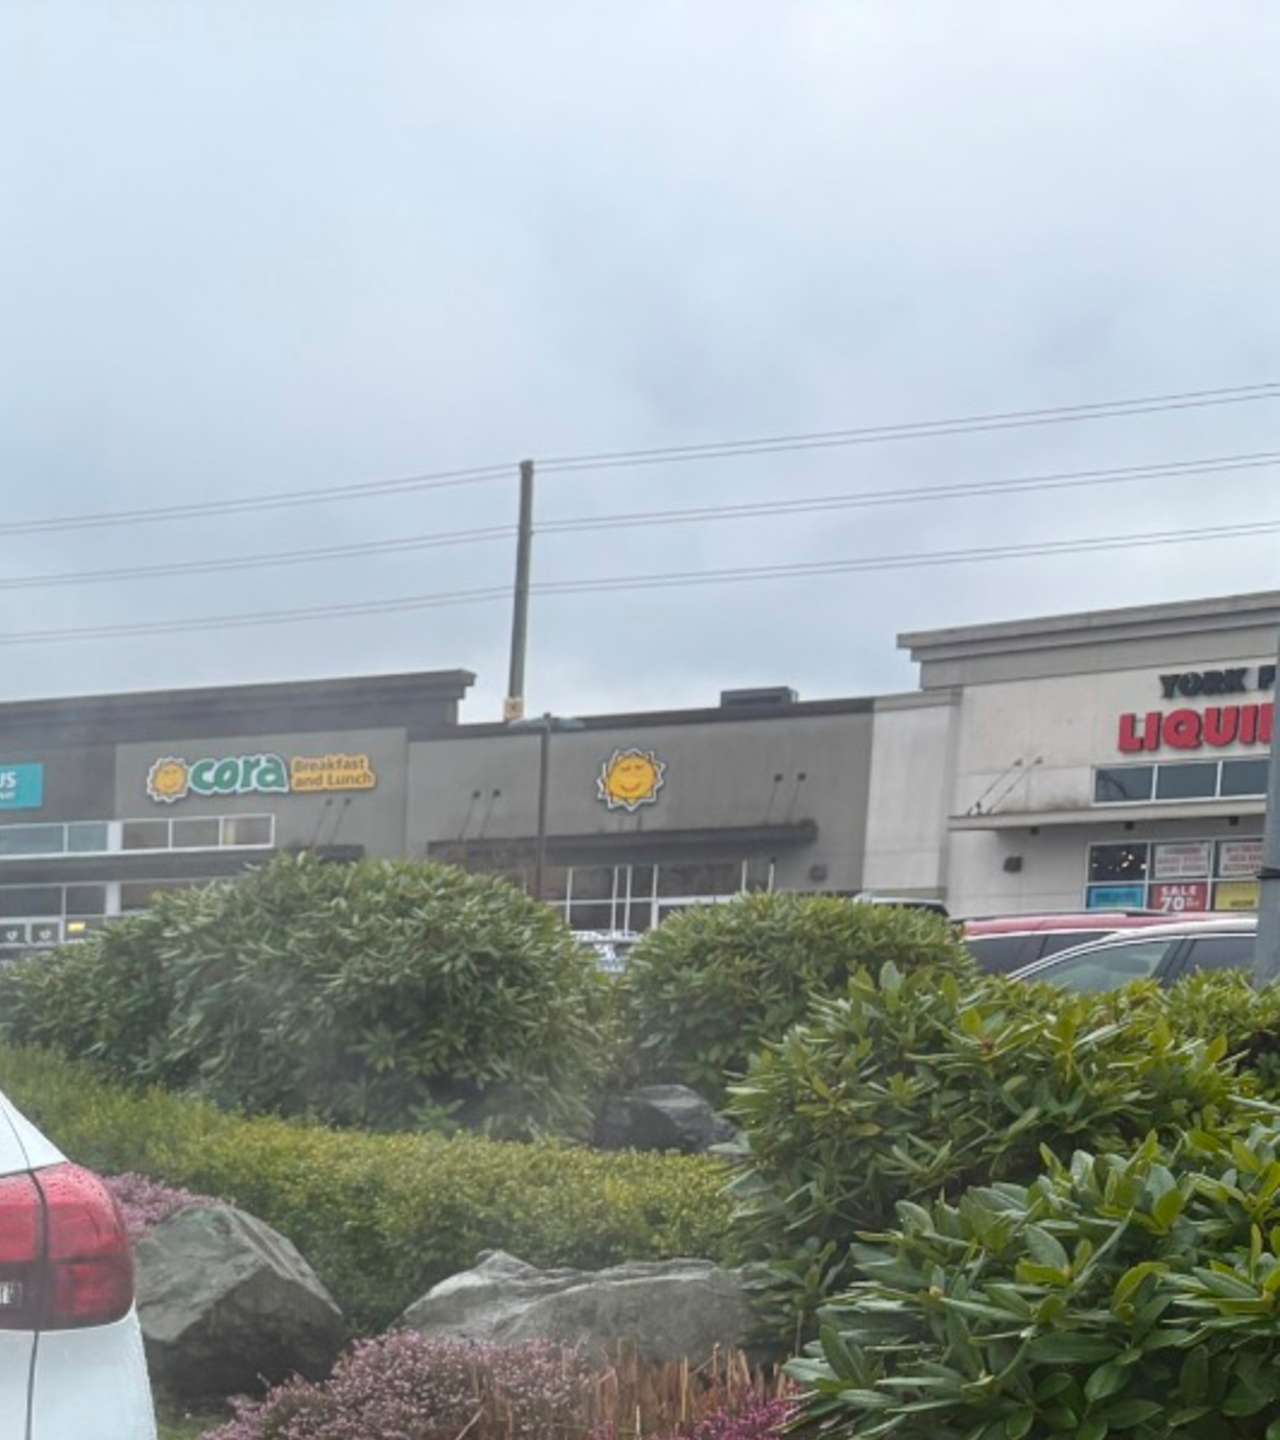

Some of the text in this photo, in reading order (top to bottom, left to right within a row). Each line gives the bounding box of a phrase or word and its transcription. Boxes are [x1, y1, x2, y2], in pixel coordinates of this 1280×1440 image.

[294, 757, 365, 772] Breakfast
[191, 756, 286, 791] cora
[295, 771, 374, 787] and Lunch
[1160, 885, 1197, 897] SALE
